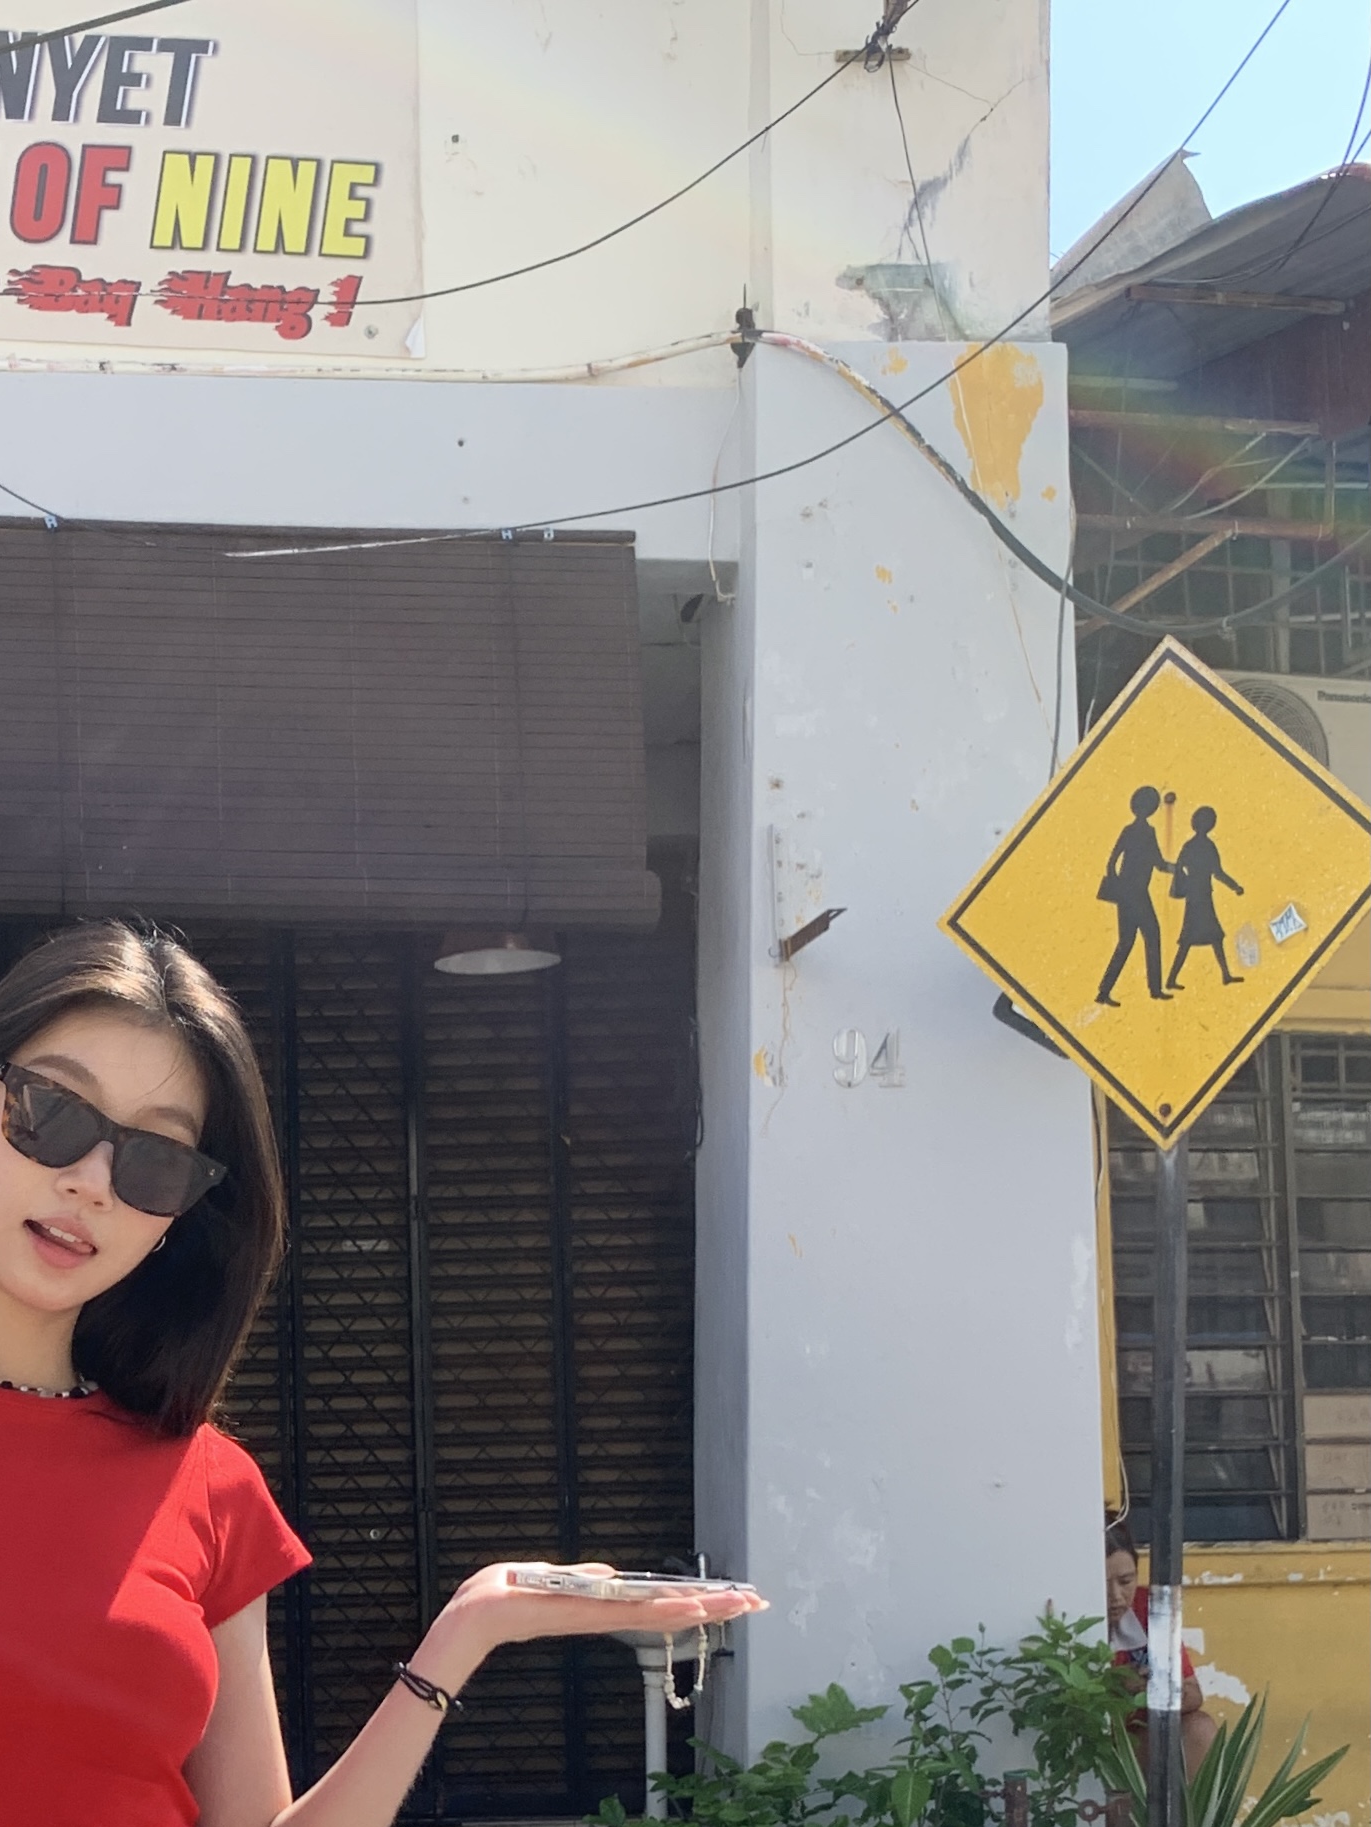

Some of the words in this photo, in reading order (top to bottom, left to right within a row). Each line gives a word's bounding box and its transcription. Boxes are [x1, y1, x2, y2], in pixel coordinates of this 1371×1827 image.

[9, 140, 132, 244] OF
[150, 150, 379, 259] NINE
[832, 1026, 906, 1089] 94
